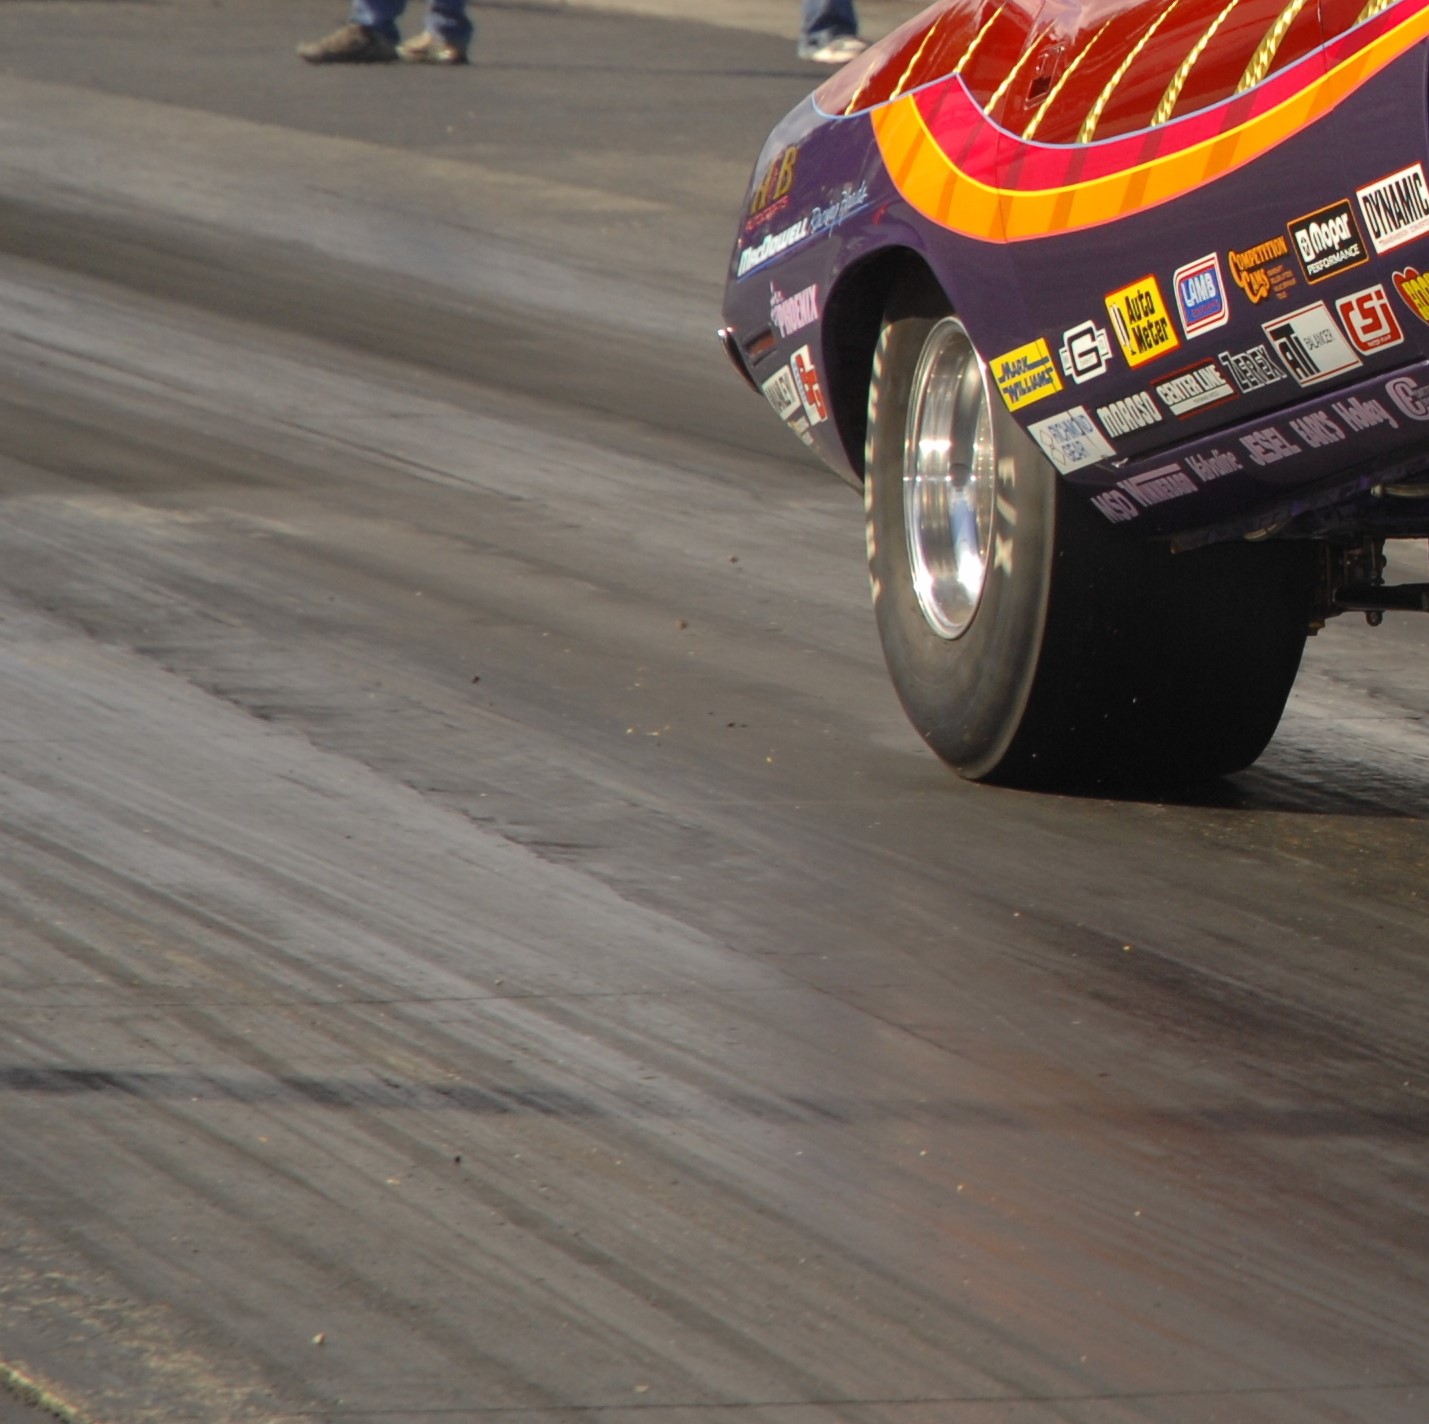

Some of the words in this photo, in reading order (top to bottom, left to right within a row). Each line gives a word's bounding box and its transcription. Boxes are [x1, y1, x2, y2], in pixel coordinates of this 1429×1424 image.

[1228, 235, 1289, 287] COMPETITION
[1306, 243, 1361, 276] PERFORMANCE
[1181, 272, 1217, 308] LAMB
[1241, 268, 1271, 304] CAMS
[1124, 289, 1156, 324] Auto
[1131, 316, 1169, 354] Meter
[1003, 366, 1053, 404] WILLIAMS
[1156, 373, 1204, 405] CENTER
[1193, 364, 1228, 392] LINE
[1218, 344, 1288, 394] ZEREX
[1096, 391, 1163, 438] MOROSO
[1331, 397, 1399, 432] Holley
[1239, 426, 1302, 466] JESEL
[1090, 489, 1140, 524] MSD
